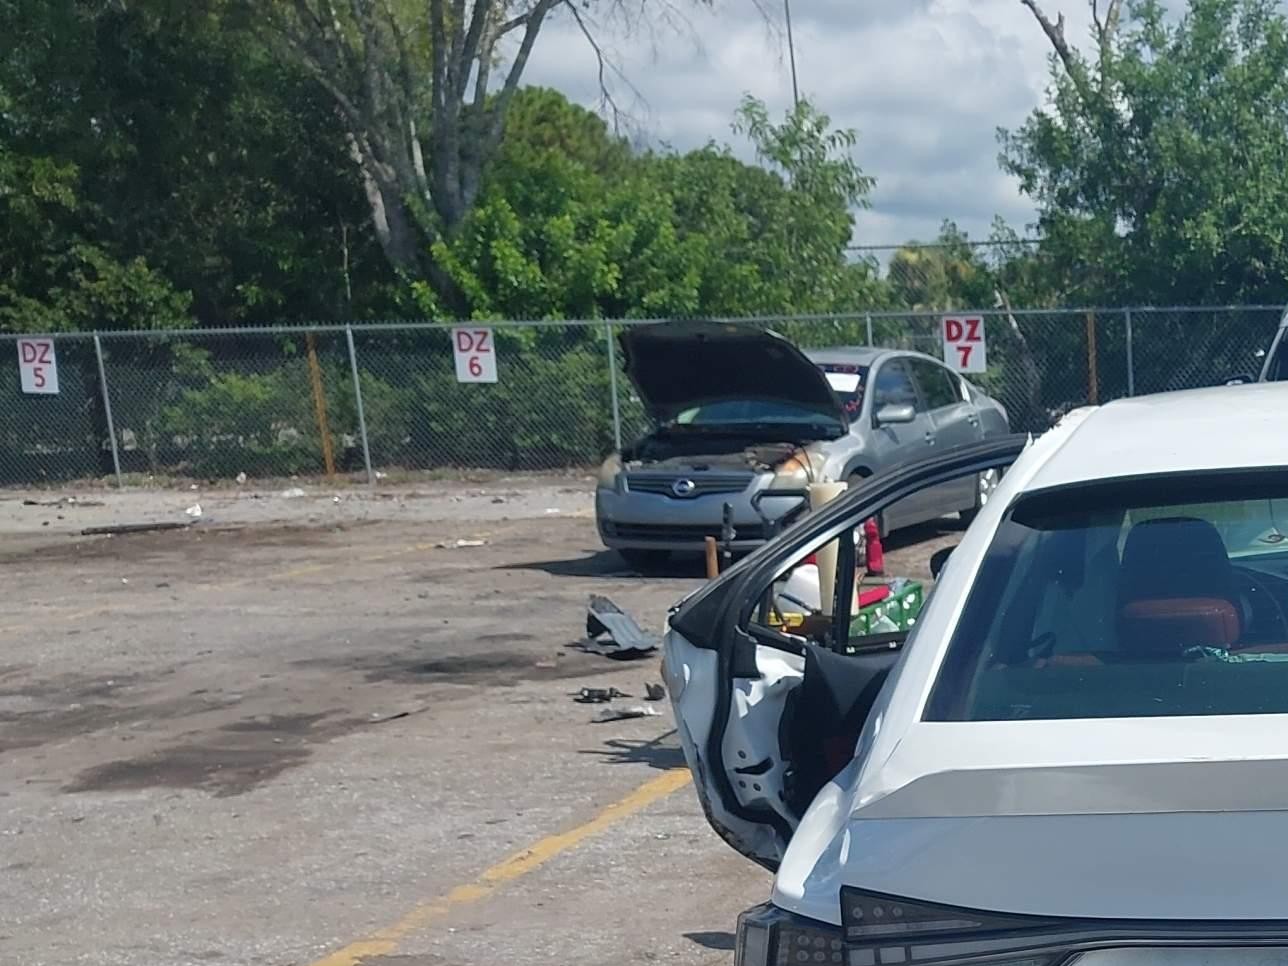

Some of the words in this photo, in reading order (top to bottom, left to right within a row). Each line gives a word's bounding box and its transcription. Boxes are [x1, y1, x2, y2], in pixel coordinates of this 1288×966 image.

[945, 319, 982, 342] DZ
[21, 342, 52, 364] DZ
[456, 331, 490, 353] DZ
[468, 356, 483, 377] 6
[956, 346, 972, 368] 7
[33, 367, 46, 388] 5
